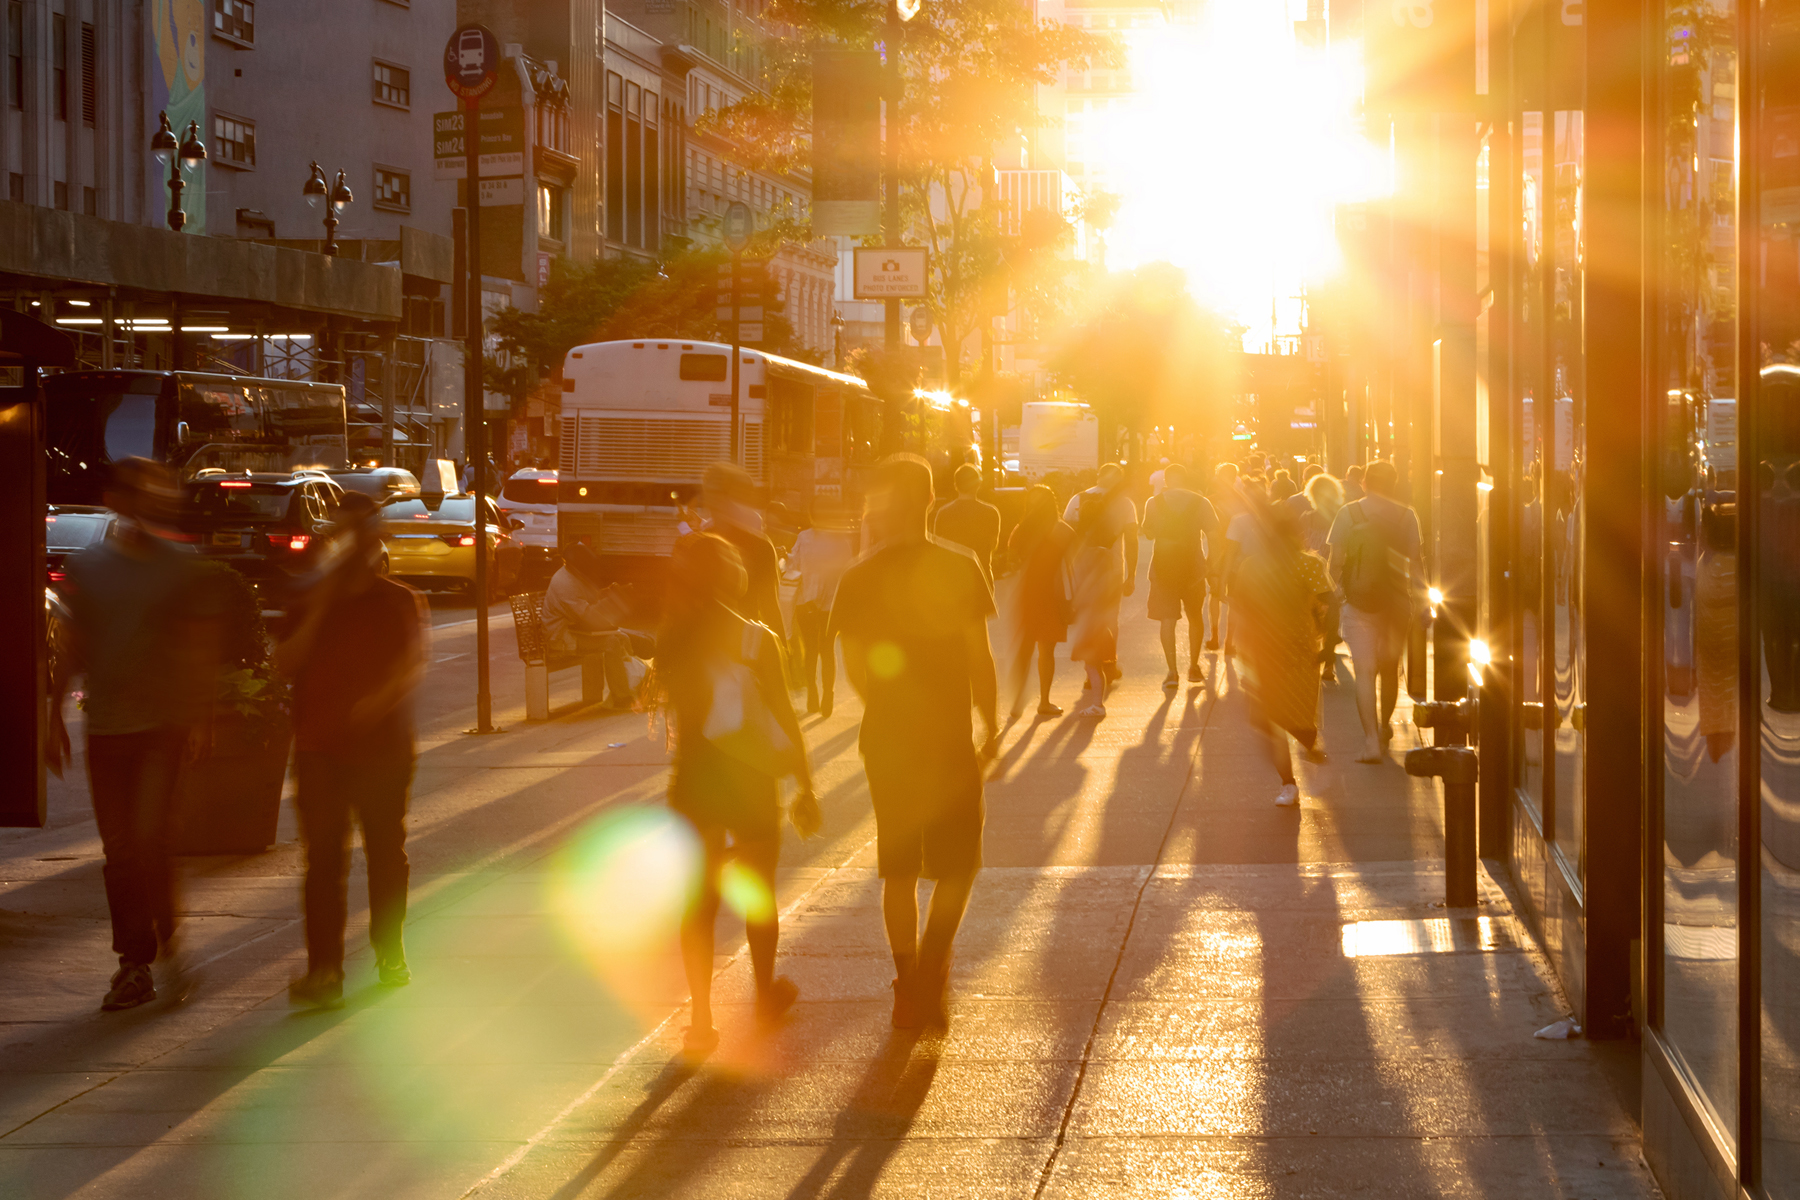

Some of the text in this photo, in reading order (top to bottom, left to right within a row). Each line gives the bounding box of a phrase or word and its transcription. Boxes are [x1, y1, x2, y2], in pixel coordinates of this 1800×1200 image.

[449, 76, 493, 96] NO STANDING
[436, 115, 464, 132] SIM23
[502, 133, 512, 142] Bay
[436, 137, 464, 154] SIM24
[481, 182, 487, 190] W
[488, 181, 495, 190] 34
[496, 181, 502, 189] St
[873, 274, 909, 282] BUS LANES
[863, 284, 919, 292] PHOTO ENFORCED
